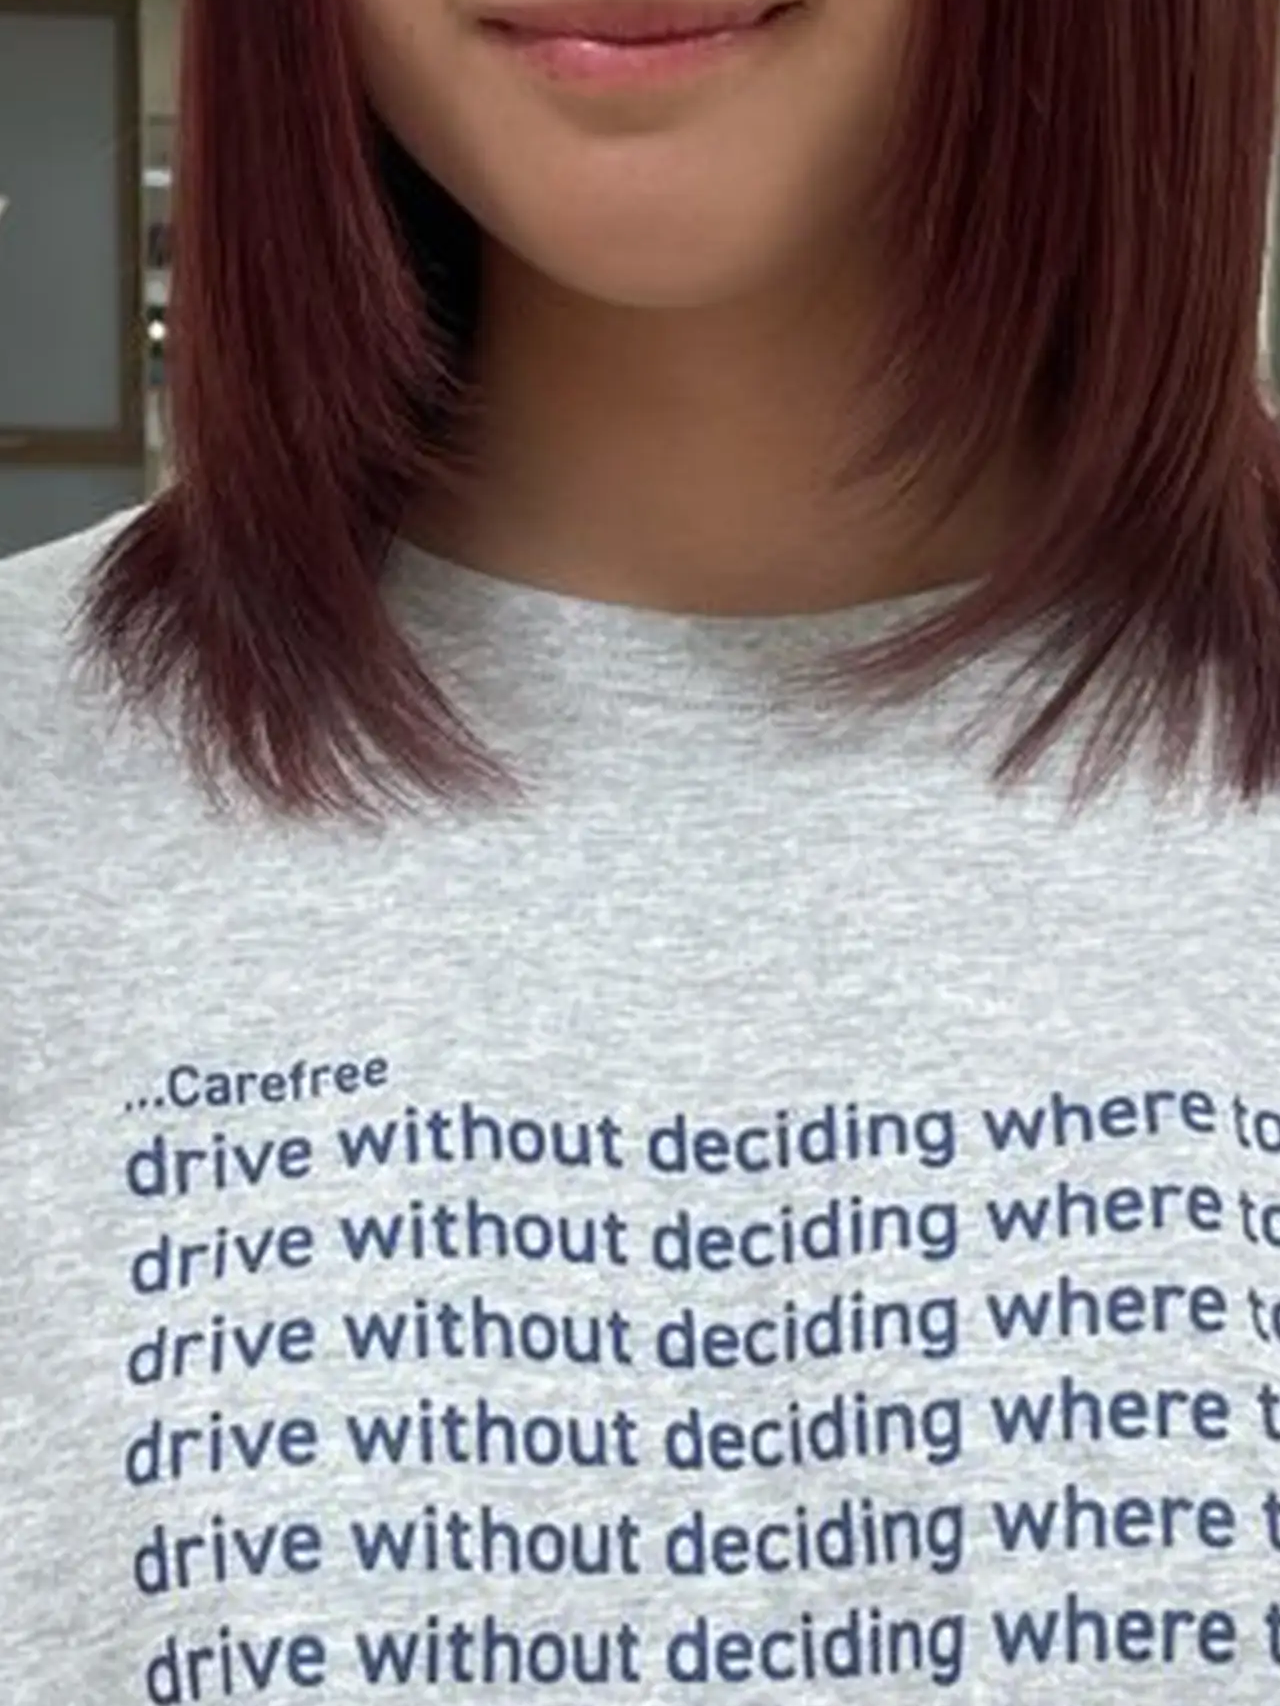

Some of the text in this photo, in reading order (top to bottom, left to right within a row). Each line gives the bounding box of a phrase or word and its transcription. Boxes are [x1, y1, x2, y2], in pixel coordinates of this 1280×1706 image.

[125, 1057, 388, 1113] ...Carefree
[125, 1132, 313, 1198] drive
[337, 1101, 624, 1169] without
[648, 1102, 955, 1175] deciding
[982, 1090, 1216, 1151] where
[131, 1225, 314, 1295] drive
[339, 1197, 628, 1267] without
[652, 1195, 958, 1273] deciding
[986, 1180, 1223, 1242] where
[127, 1314, 315, 1386] drive
[343, 1295, 633, 1366] without
[656, 1289, 958, 1370] deciding
[986, 1275, 1227, 1339] where
[125, 1410, 318, 1487] drive
[345, 1397, 640, 1467] without
[664, 1391, 962, 1472] deciding
[990, 1375, 1230, 1444] where
[133, 1513, 322, 1596] drive
[350, 1504, 640, 1575] without
[665, 1497, 964, 1576] deciding
[991, 1483, 1236, 1552] where
[355, 1614, 641, 1685] without
[666, 1606, 964, 1687] deciding
[991, 1592, 1237, 1665] where
